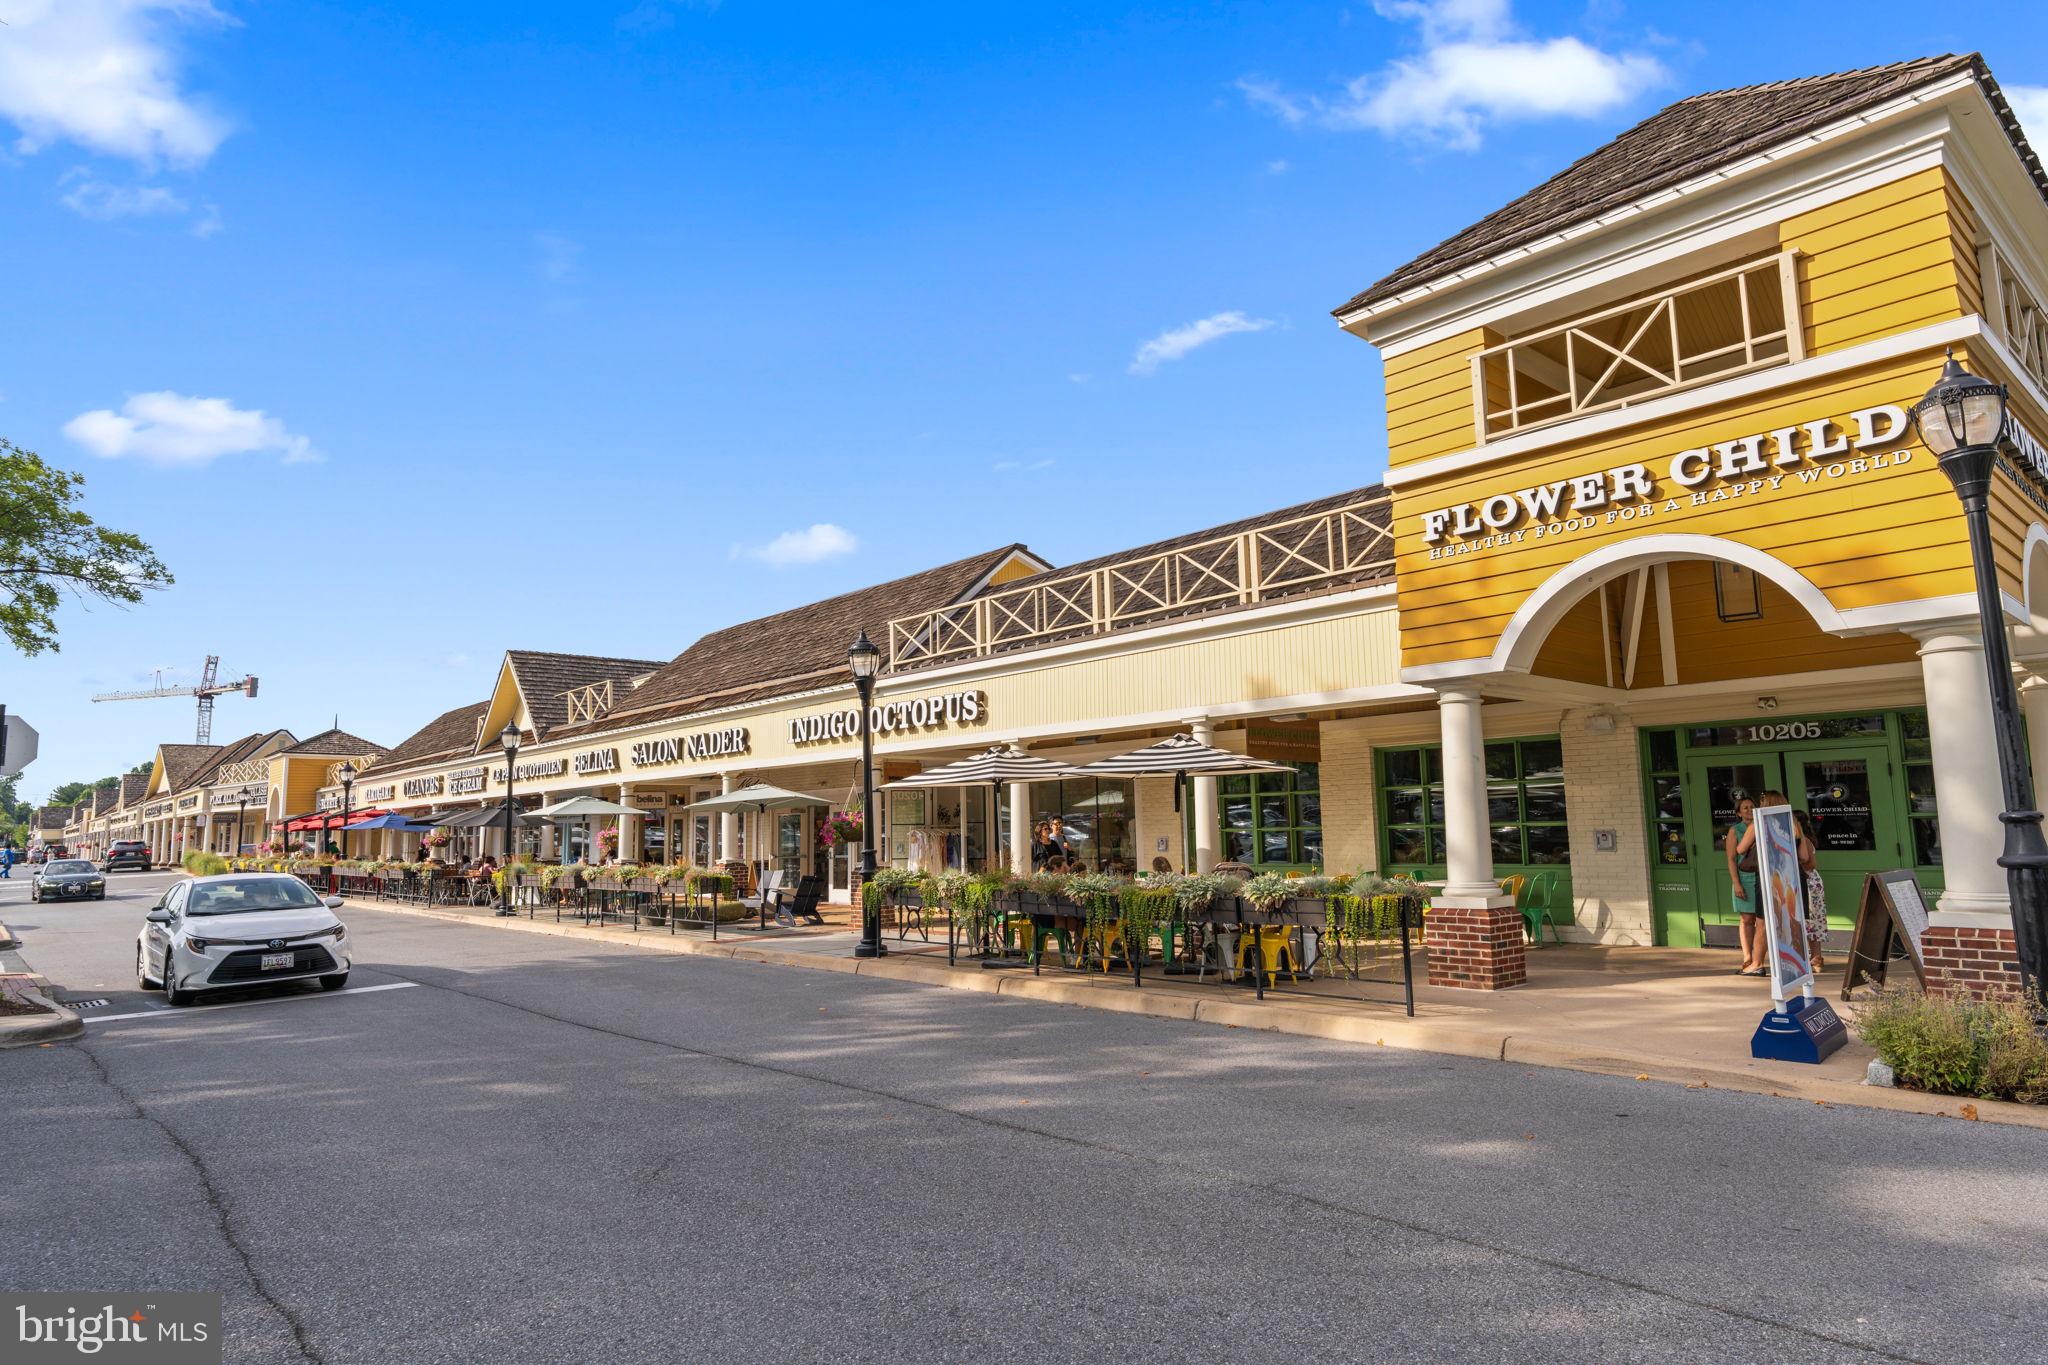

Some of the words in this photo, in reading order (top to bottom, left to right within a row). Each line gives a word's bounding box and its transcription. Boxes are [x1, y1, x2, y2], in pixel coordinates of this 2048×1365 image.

[1420, 463, 1655, 544] FLOWER
[1669, 404, 1910, 487] CHILD
[1429, 530, 1528, 560] HEALTHY
[1535, 515, 1598, 539] FOOD
[1606, 503, 1655, 524] FOR
[1663, 498, 1681, 512] A
[1690, 474, 1784, 507] HAPPY
[1796, 449, 1913, 483] WORLD
[787, 708, 860, 744] INDIGO
[869, 690, 978, 734] OCTOPUS
[1748, 721, 1822, 742] 10205
[631, 737, 679, 766] SALON
[687, 727, 745, 759] NADER
[501, 765, 519, 782] PAN
[519, 758, 563, 780] QUOTIDIEN
[573, 747, 615, 774] BELINA
[636, 794, 663, 803] belina
[1805, 1009, 1837, 1034] WILDWOOD
